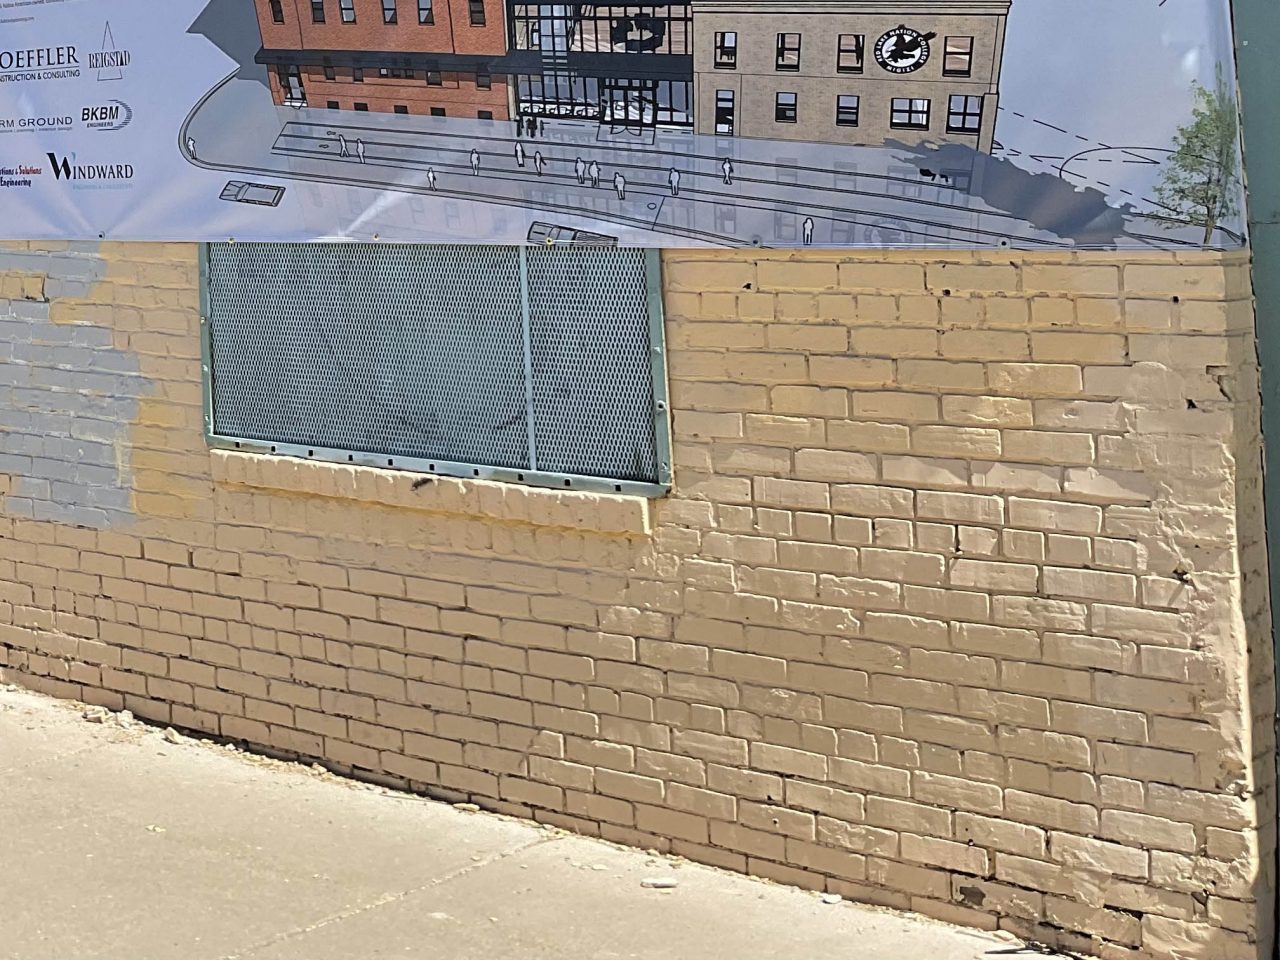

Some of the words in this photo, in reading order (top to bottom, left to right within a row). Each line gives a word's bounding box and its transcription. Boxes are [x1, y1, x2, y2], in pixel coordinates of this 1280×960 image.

[889, 29, 917, 38] NATION
[88, 50, 130, 69] REIGSTAD
[43, 69, 80, 79] CONSULTING
[81, 106, 119, 121] BKBM
[19, 116, 73, 127] GROUND
[19, 165, 42, 175] Solutions
[46, 152, 133, 180] WINDWARD
[0, 177, 32, 187] Engineering
